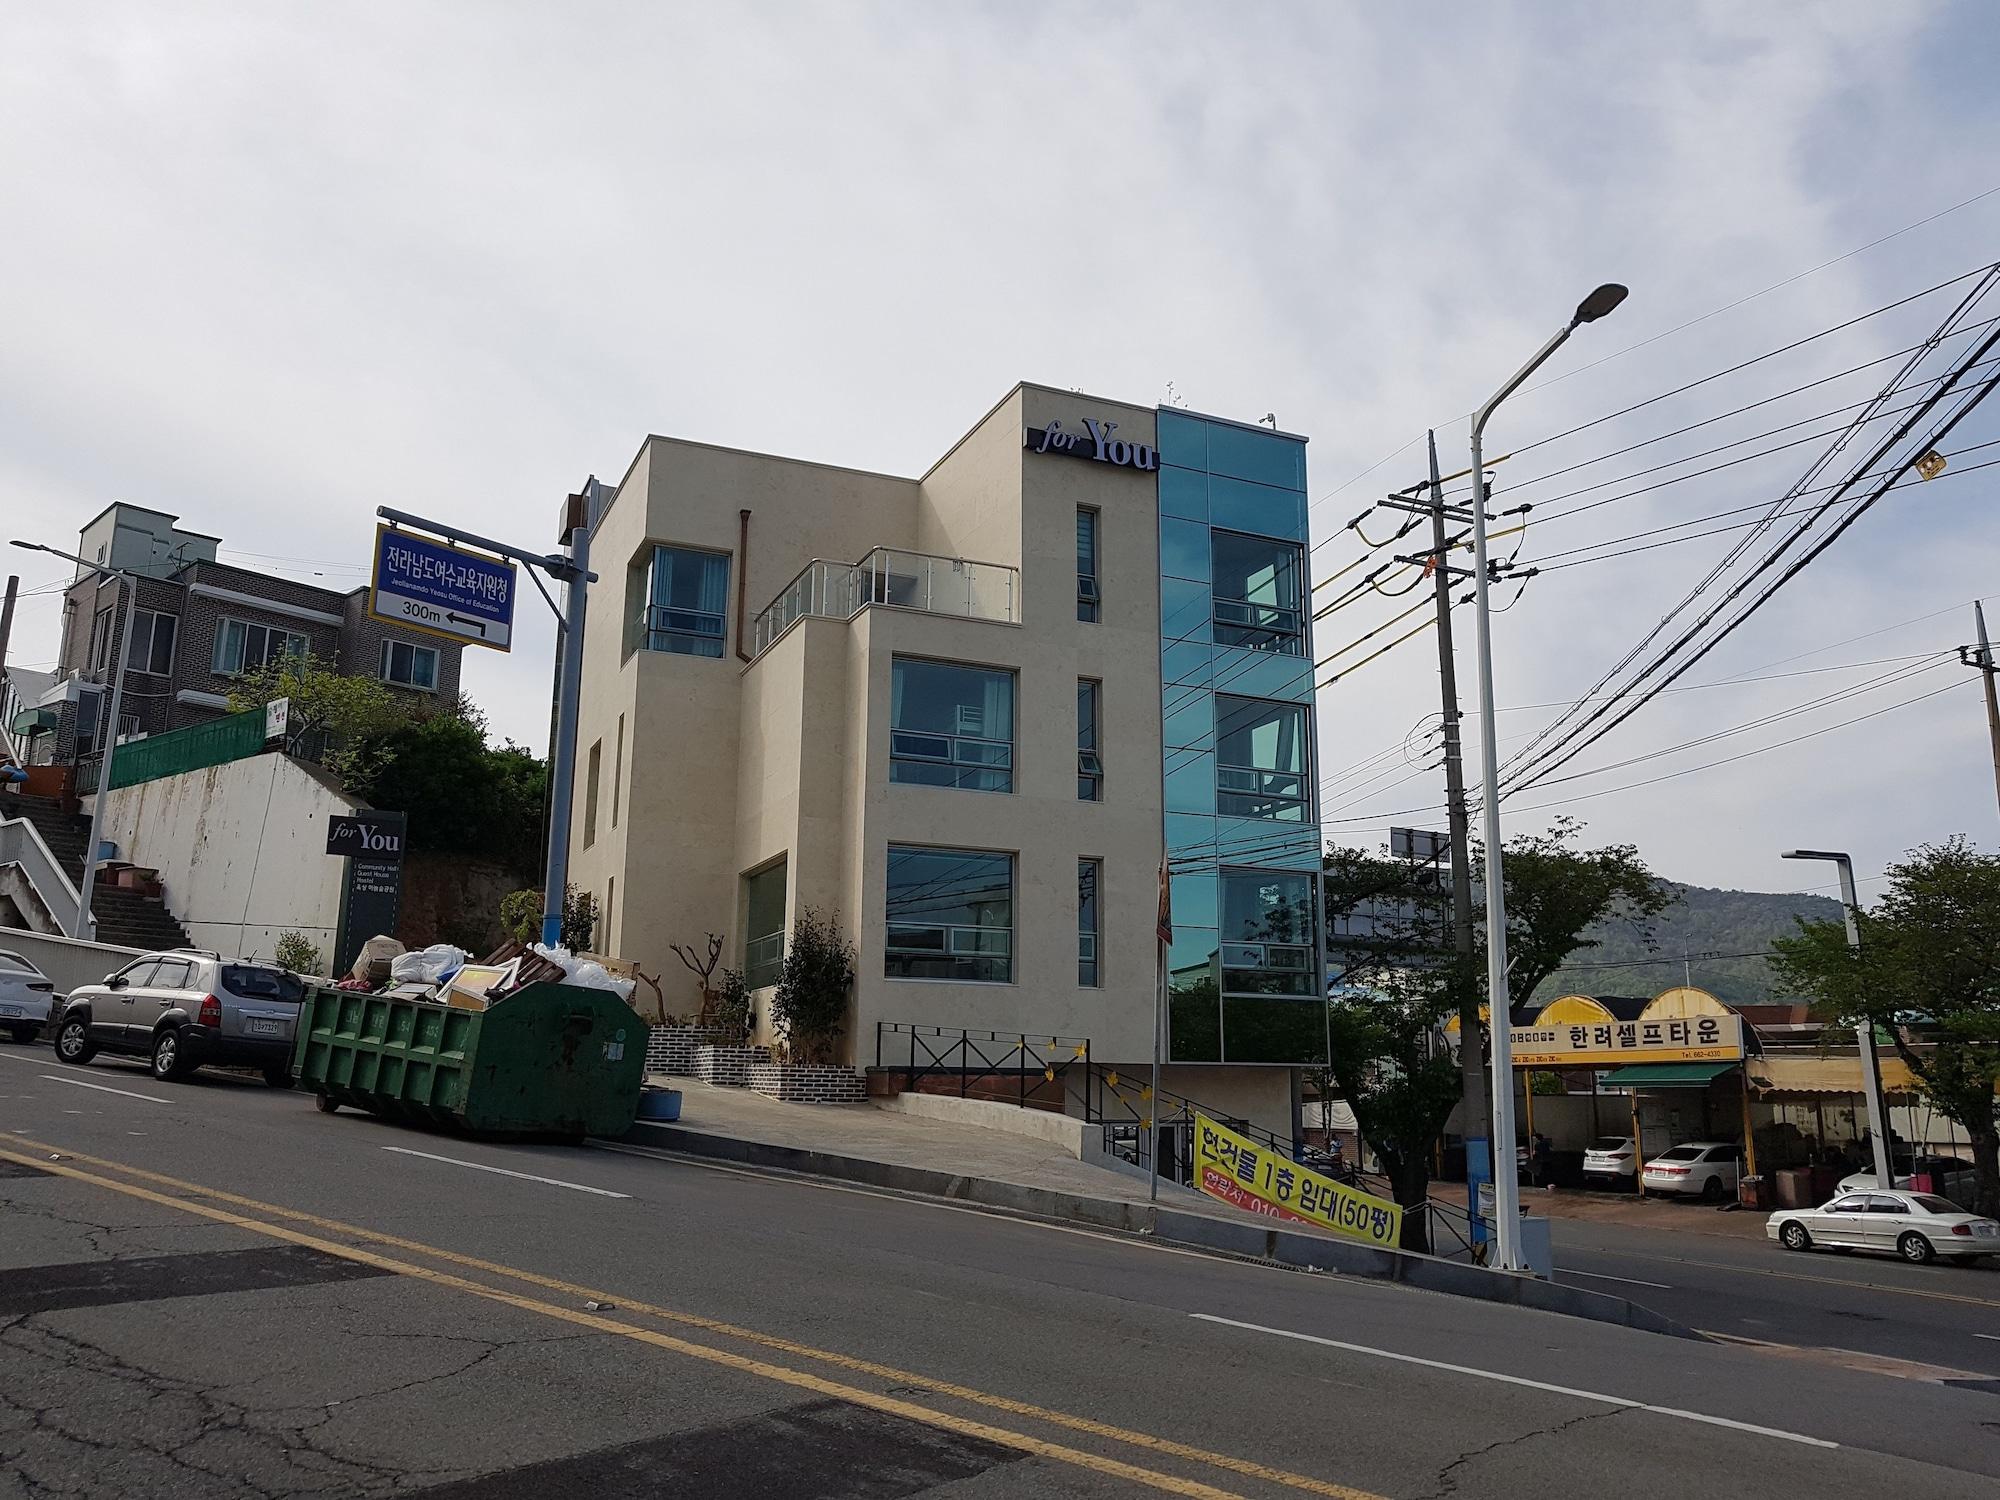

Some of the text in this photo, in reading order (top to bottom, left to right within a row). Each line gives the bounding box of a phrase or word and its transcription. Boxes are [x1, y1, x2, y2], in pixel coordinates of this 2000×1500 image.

[1036, 417, 1156, 470] for You
[387, 546, 507, 604] 전라남도여수교육지원청
[391, 577, 429, 594] Jeollanamdo
[429, 587, 448, 599] Yeosu
[448, 592, 465, 604] Office
[472, 599, 500, 613] Education
[402, 601, 441, 623] 300m
[329, 822, 399, 851] for You
[356, 870, 373, 878] Guest
[357, 863, 386, 872] Community
[1569, 1018, 1720, 1049] 한려셀프타운
[1201, 1126, 1258, 1185] 현건물
